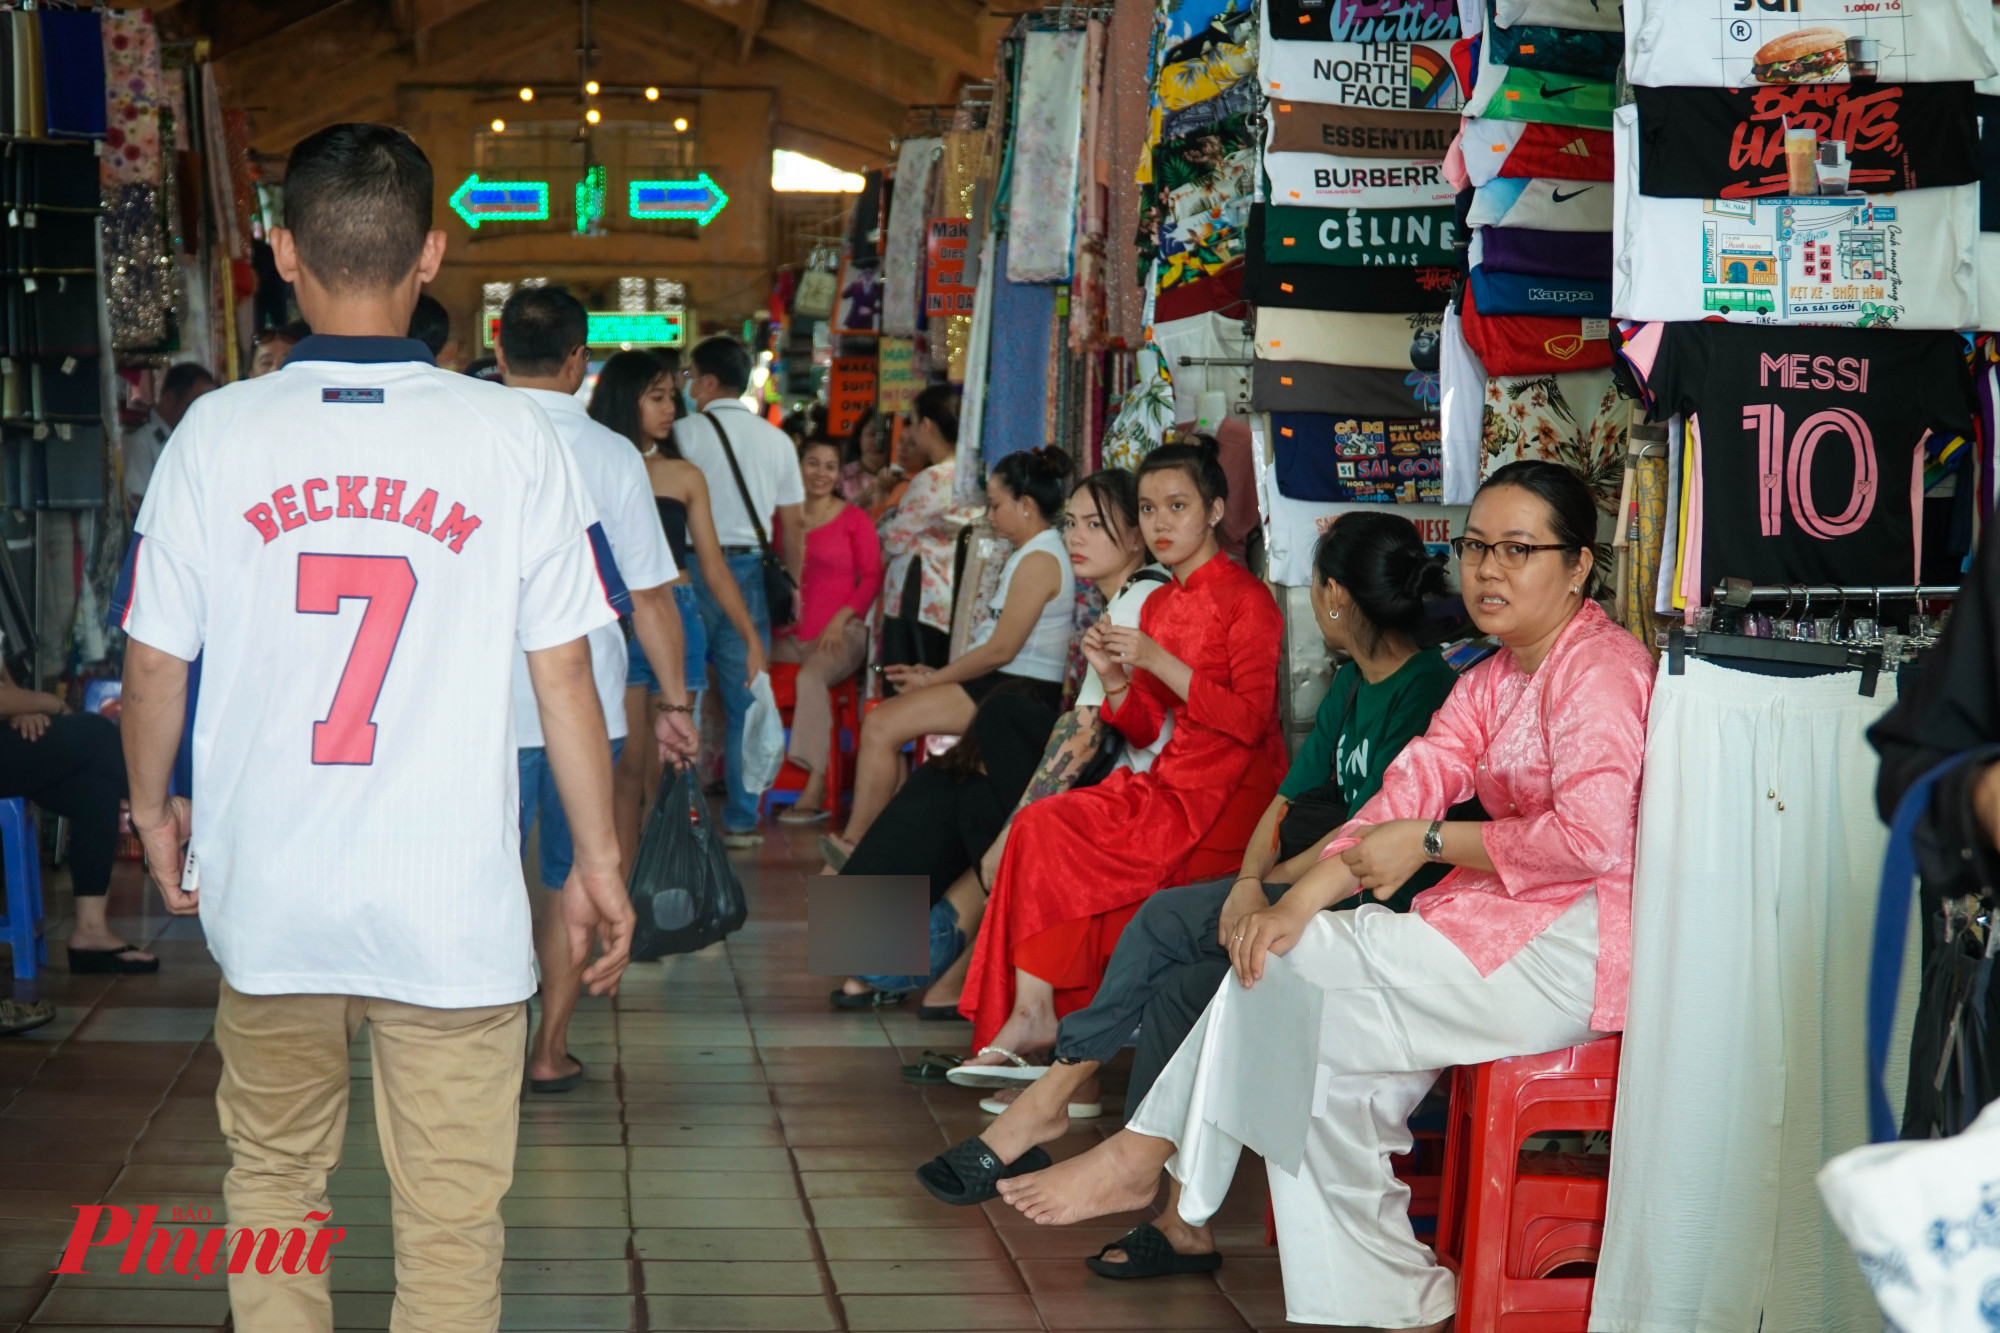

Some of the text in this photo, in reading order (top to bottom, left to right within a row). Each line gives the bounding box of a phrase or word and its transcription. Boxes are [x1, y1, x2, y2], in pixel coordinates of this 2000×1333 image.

[1360, 42, 1408, 63] THE
[1313, 59, 1408, 85] NORTH
[1340, 84, 1407, 109] FACE
[932, 222, 969, 238] Mak
[940, 246, 965, 260] Dres
[1362, 253, 1418, 266] PARIS
[957, 293, 975, 310] DA
[1528, 288, 1593, 301] Kappa
[1760, 352, 1869, 393] MESSI
[1742, 403, 1879, 540] 10
[243, 475, 482, 554] BECKHAM
[296, 552, 418, 766] 7
